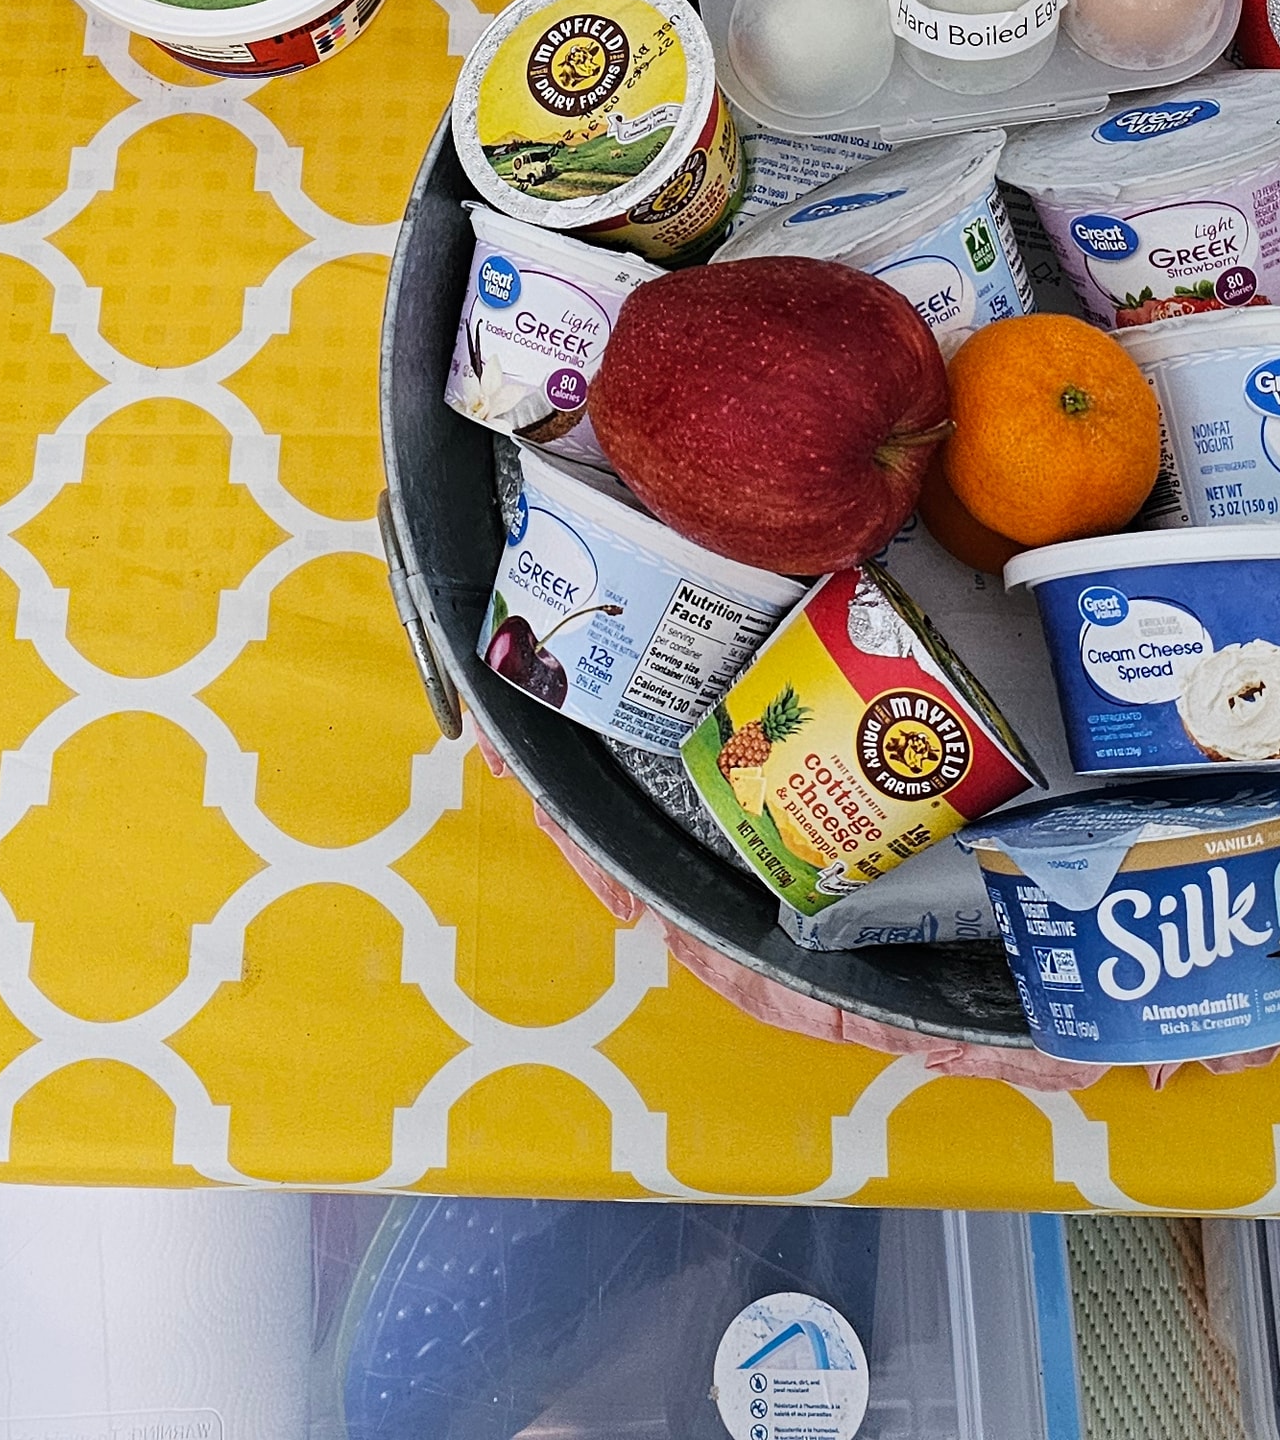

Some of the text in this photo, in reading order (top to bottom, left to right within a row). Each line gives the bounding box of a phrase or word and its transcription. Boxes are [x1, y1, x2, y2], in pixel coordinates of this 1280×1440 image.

[535, 17, 625, 65] MAYFIELD
[949, 17, 1028, 47] Boiled
[535, 63, 621, 110] DAIRY FARMS
[1116, 105, 1202, 127] Great
[1126, 117, 1189, 136] Value
[1075, 224, 1125, 242] Great
[1194, 216, 1235, 242] Light
[1088, 239, 1128, 252] Value
[1148, 234, 1239, 269] GREEK
[482, 262, 514, 290] Great
[1166, 255, 1240, 279] Strawberry
[484, 281, 511, 302] Value
[1222, 281, 1255, 302] Calories
[1226, 271, 1244, 290] 80
[561, 309, 600, 336] Light
[928, 304, 961, 328] Plain
[485, 320, 585, 369] Toasted Coconut Vanilla
[515, 311, 594, 359] GREEK
[559, 375, 577, 392] 80
[550, 388, 581, 404] Calories
[1192, 420, 1231, 440] NONFAT
[1194, 436, 1235, 455] YOGURT
[1205, 483, 1243, 501] NET WT
[1210, 501, 1241, 518] 5.3 OZ
[517, 550, 580, 605] GREEK
[508, 567, 572, 616] Black Cherry
[1084, 595, 1120, 612] Great
[670, 602, 713, 630] Facts
[678, 586, 743, 624] Nutrition
[668, 627, 696, 647] serving
[589, 645, 615, 668] 12g
[649, 646, 700, 675] Serving size
[669, 641, 703, 660] container
[1087, 639, 1204, 665] Cream Cheese
[577, 656, 613, 683] Protein
[650, 661, 684, 681] container
[1118, 661, 1174, 683] Spread
[587, 680, 602, 695] Fat
[633, 675, 691, 714] Calories 130
[641, 691, 666, 708] serving
[889, 696, 966, 779] MAYFIELD
[862, 718, 882, 768] DAIRY
[875, 771, 932, 796] FARMS
[804, 753, 883, 843] cottage
[776, 786, 839, 861] & pineapple
[788, 772, 859, 853] cheese
[736, 819, 797, 889] NET WT OZ (150g)
[1204, 832, 1265, 855] VANILLA
[1020, 902, 1050, 919] YOGURT
[1026, 919, 1077, 937] ALTERNATIVE
[1097, 866, 1273, 1001] Silk
[1142, 992, 1251, 1021] Almondmilk
[1160, 1012, 1252, 1035] Rich & Creamy
